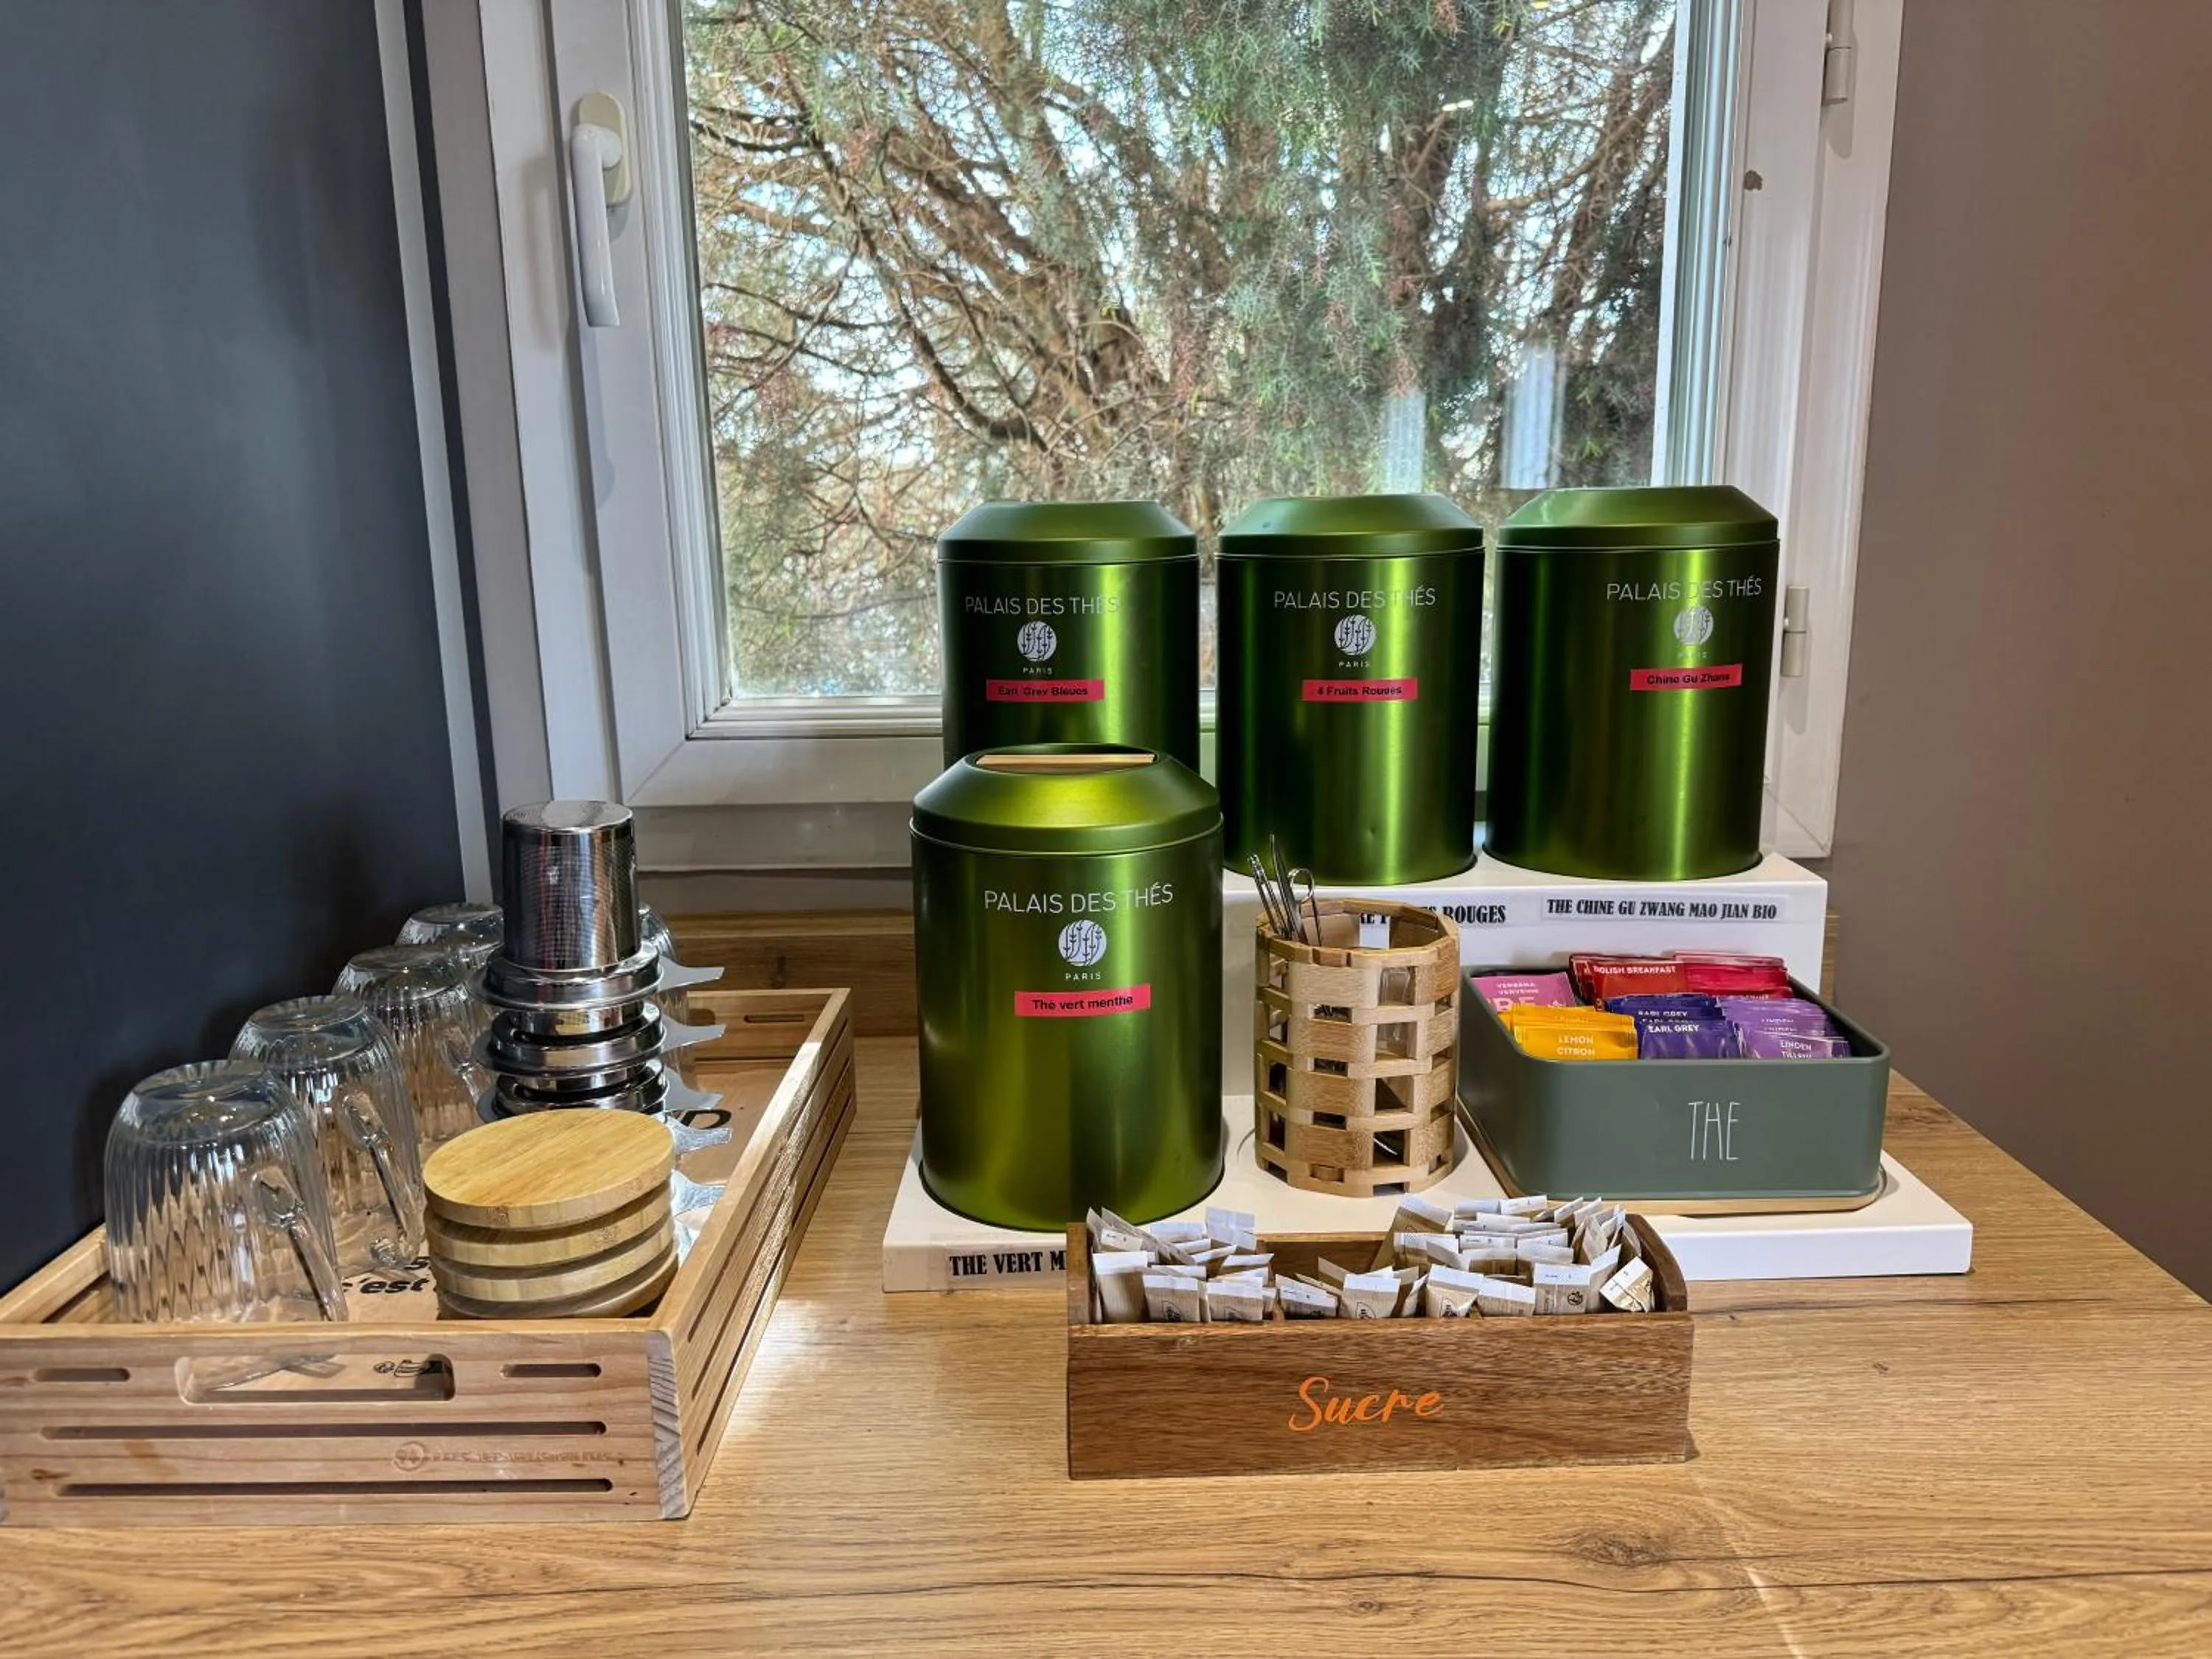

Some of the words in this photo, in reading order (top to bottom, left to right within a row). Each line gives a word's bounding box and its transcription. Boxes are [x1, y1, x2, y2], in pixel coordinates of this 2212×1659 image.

[1607, 582, 1680, 600] PALAIS
[1727, 574, 1761, 597] THÉS
[965, 595, 1020, 614] PALAIS
[1026, 598, 1064, 615] DES
[1274, 591, 1340, 608] PALAIS
[1346, 591, 1385, 608] DES
[1023, 667, 1052, 675] PARIS
[1683, 674, 1698, 684] Gu
[984, 890, 1063, 914] PALAIS
[1071, 891, 1116, 914] DES
[1121, 882, 1173, 908] THÉS
[1442, 905, 1506, 923] ROUGES
[1547, 899, 1572, 914] THE
[1576, 900, 1615, 914] CHINE
[1618, 901, 1635, 915] GU
[1640, 902, 1685, 917] ZWANG
[1688, 902, 1717, 917] MAO
[1720, 903, 1749, 919] JIAN
[1753, 905, 1777, 919] BIO
[1059, 1000, 1085, 1009] vert
[1088, 996, 1133, 1009] menthe
[1674, 1024, 1699, 1032] GREY
[1558, 1035, 1593, 1044] LEMON
[1557, 1047, 1595, 1056] CITRON
[1688, 1101, 1740, 1160] THE
[950, 1255, 987, 1276] THE
[993, 1251, 1043, 1274] VERT
[1288, 1377, 1444, 1431] Sucre
